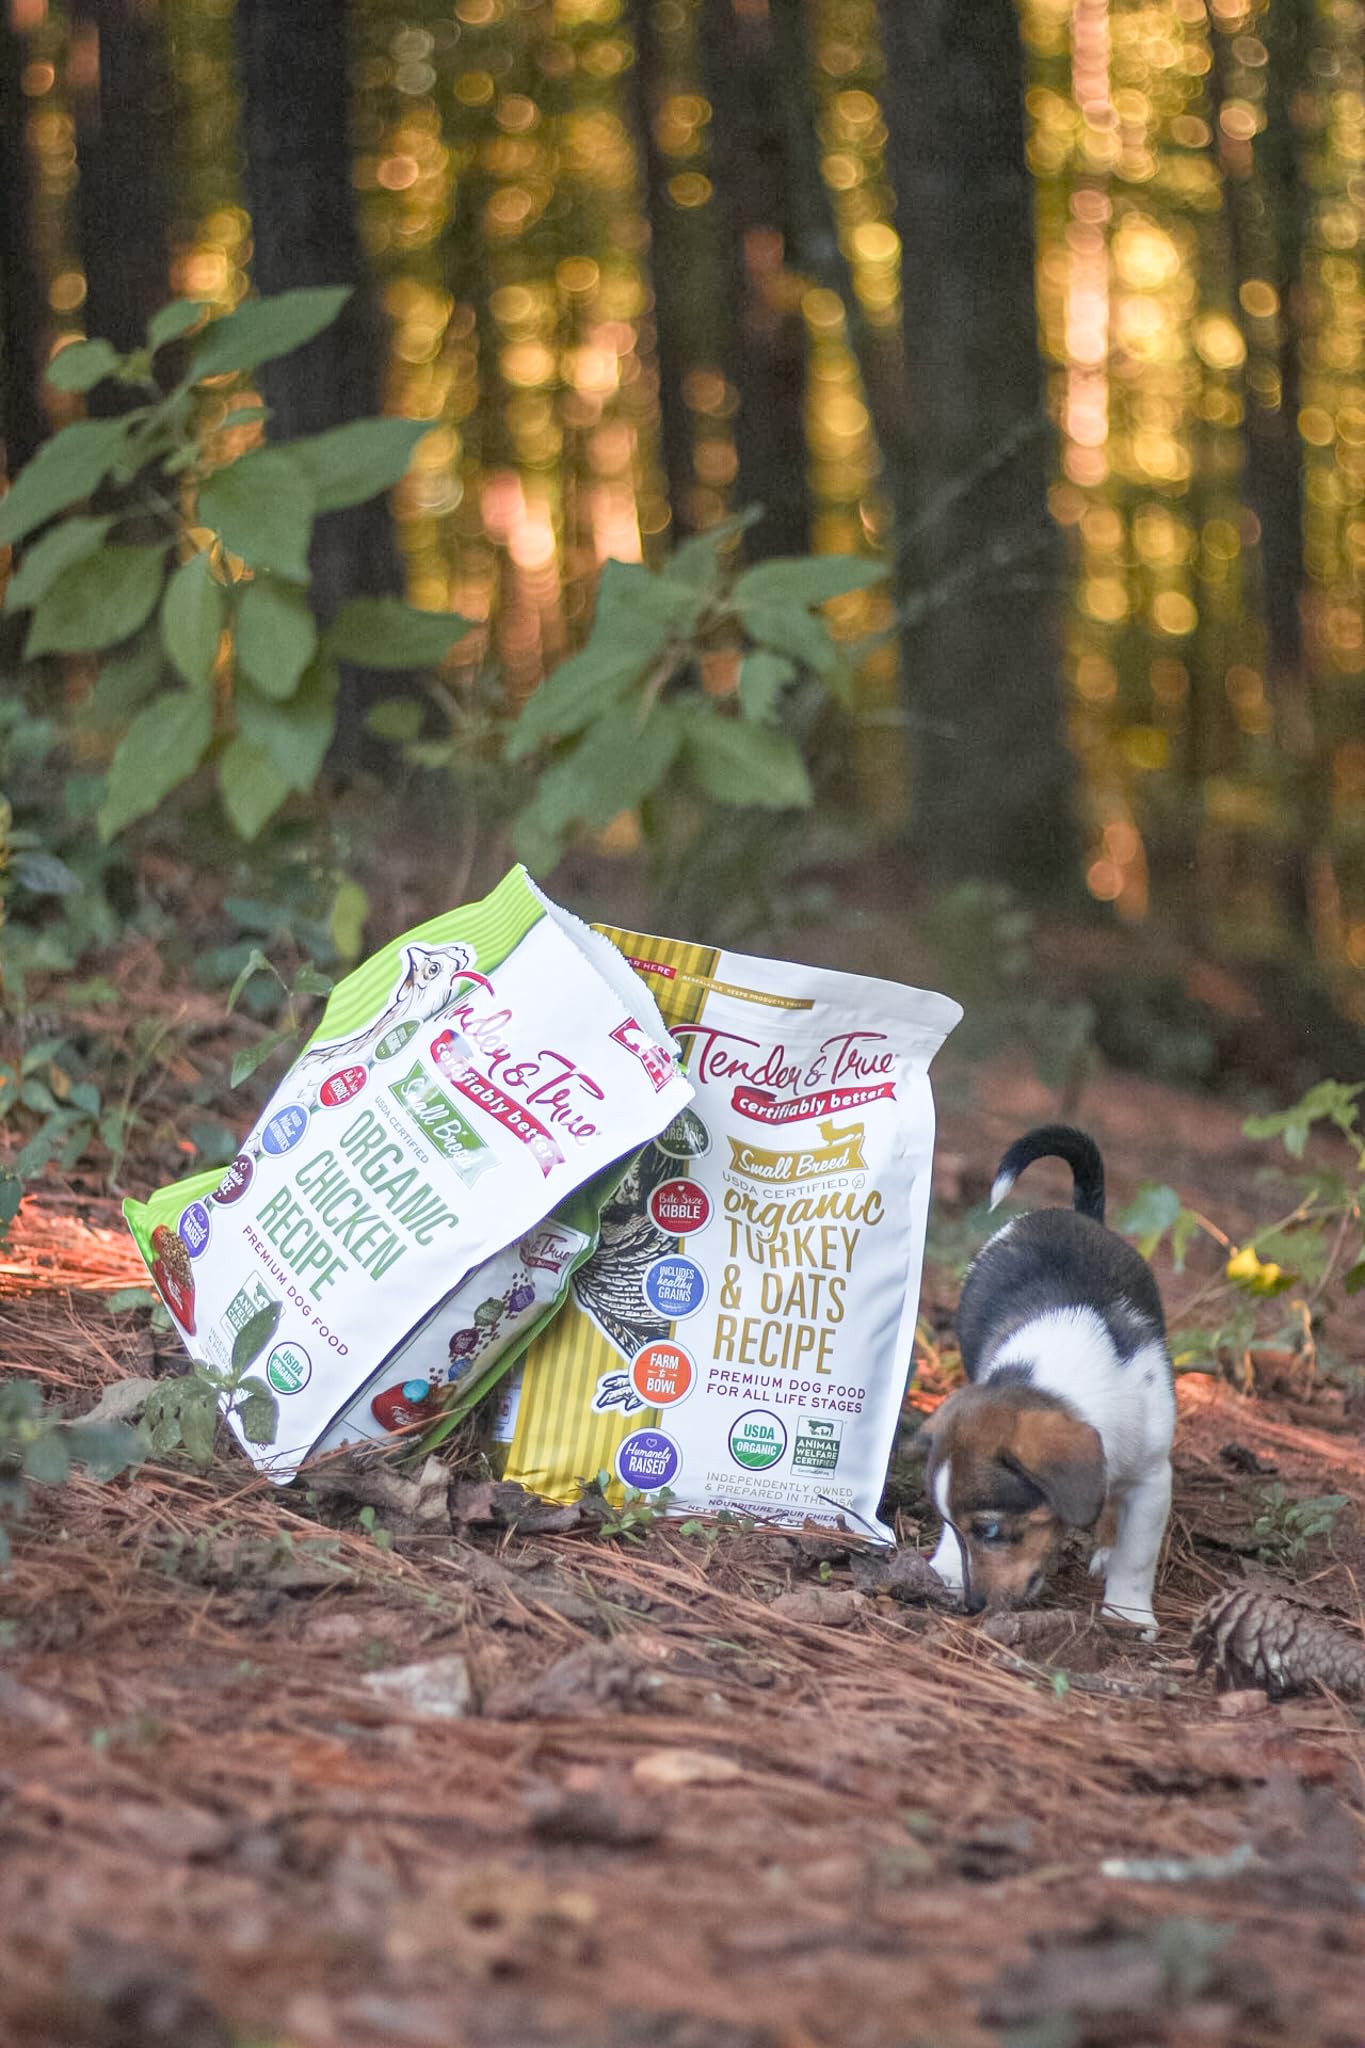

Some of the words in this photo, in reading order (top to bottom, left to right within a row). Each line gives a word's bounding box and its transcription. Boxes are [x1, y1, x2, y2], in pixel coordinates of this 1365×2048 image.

[643, 963, 671, 976] HERE
[668, 1024, 801, 1096] Tender
[804, 1055, 827, 1087] &
[820, 1031, 897, 1085] True
[330, 1077, 350, 1101] KIBBLE
[436, 1041, 509, 1116] certifiably
[509, 1108, 554, 1158] better
[503, 1063, 540, 1089] &
[526, 1050, 606, 1145] True
[739, 1096, 827, 1120] certifiably
[830, 1086, 886, 1108] better
[374, 1095, 391, 1119] USDA
[389, 1116, 429, 1164] CERTIFIED
[400, 1077, 450, 1125] Small
[433, 1120, 483, 1168] Breed
[340, 1109, 459, 1246] ORGANIC
[738, 1149, 793, 1180] Small
[796, 1148, 850, 1177] Breed
[722, 1170, 758, 1196] USDA
[763, 1179, 849, 1199] CERTIFIED
[295, 1150, 408, 1281] CHICKEN
[659, 1204, 701, 1219] KIBBLE
[724, 1188, 885, 1244] organic
[183, 1216, 201, 1248] RAISED
[256, 1185, 349, 1301] RECIPE
[724, 1215, 860, 1273] TURKEY
[657, 1274, 693, 1294] healthy
[659, 1266, 695, 1280] INCLUDES
[243, 1225, 288, 1285] PREMIUM
[286, 1286, 312, 1316] DOG
[311, 1317, 349, 1356] FOOD
[658, 1287, 691, 1302] GRAINS
[720, 1264, 742, 1310] &
[761, 1272, 846, 1324] OATS
[713, 1313, 836, 1375] RECIPE
[272, 1359, 298, 1388] ORGANIC
[282, 1349, 304, 1376] USDA
[650, 1353, 680, 1370] FARM
[647, 1378, 676, 1395] BOWL
[707, 1383, 738, 1397] FOR
[743, 1390, 770, 1402] ALL
[775, 1392, 806, 1407] LIFE
[811, 1397, 862, 1414] STAGES
[709, 1369, 783, 1389] PREMIUM
[789, 1379, 821, 1394] DOG
[827, 1385, 866, 1399] FOOD
[744, 1423, 775, 1440] USDA
[797, 1439, 838, 1451] ANIMAL
[625, 1441, 672, 1464] Humanely
[736, 1441, 777, 1457] ORGANIC
[795, 1456, 836, 1467] CERTIFIED
[796, 1448, 838, 1460] WELFARE
[628, 1456, 666, 1475] RAISED
[707, 1472, 809, 1493] INDEPENDENTLY
[813, 1486, 853, 1497] OWNED
[717, 1485, 783, 1500] PREPARED
[786, 1493, 800, 1502] IN
[803, 1494, 826, 1506] THE
[775, 1508, 804, 1518] POUR
